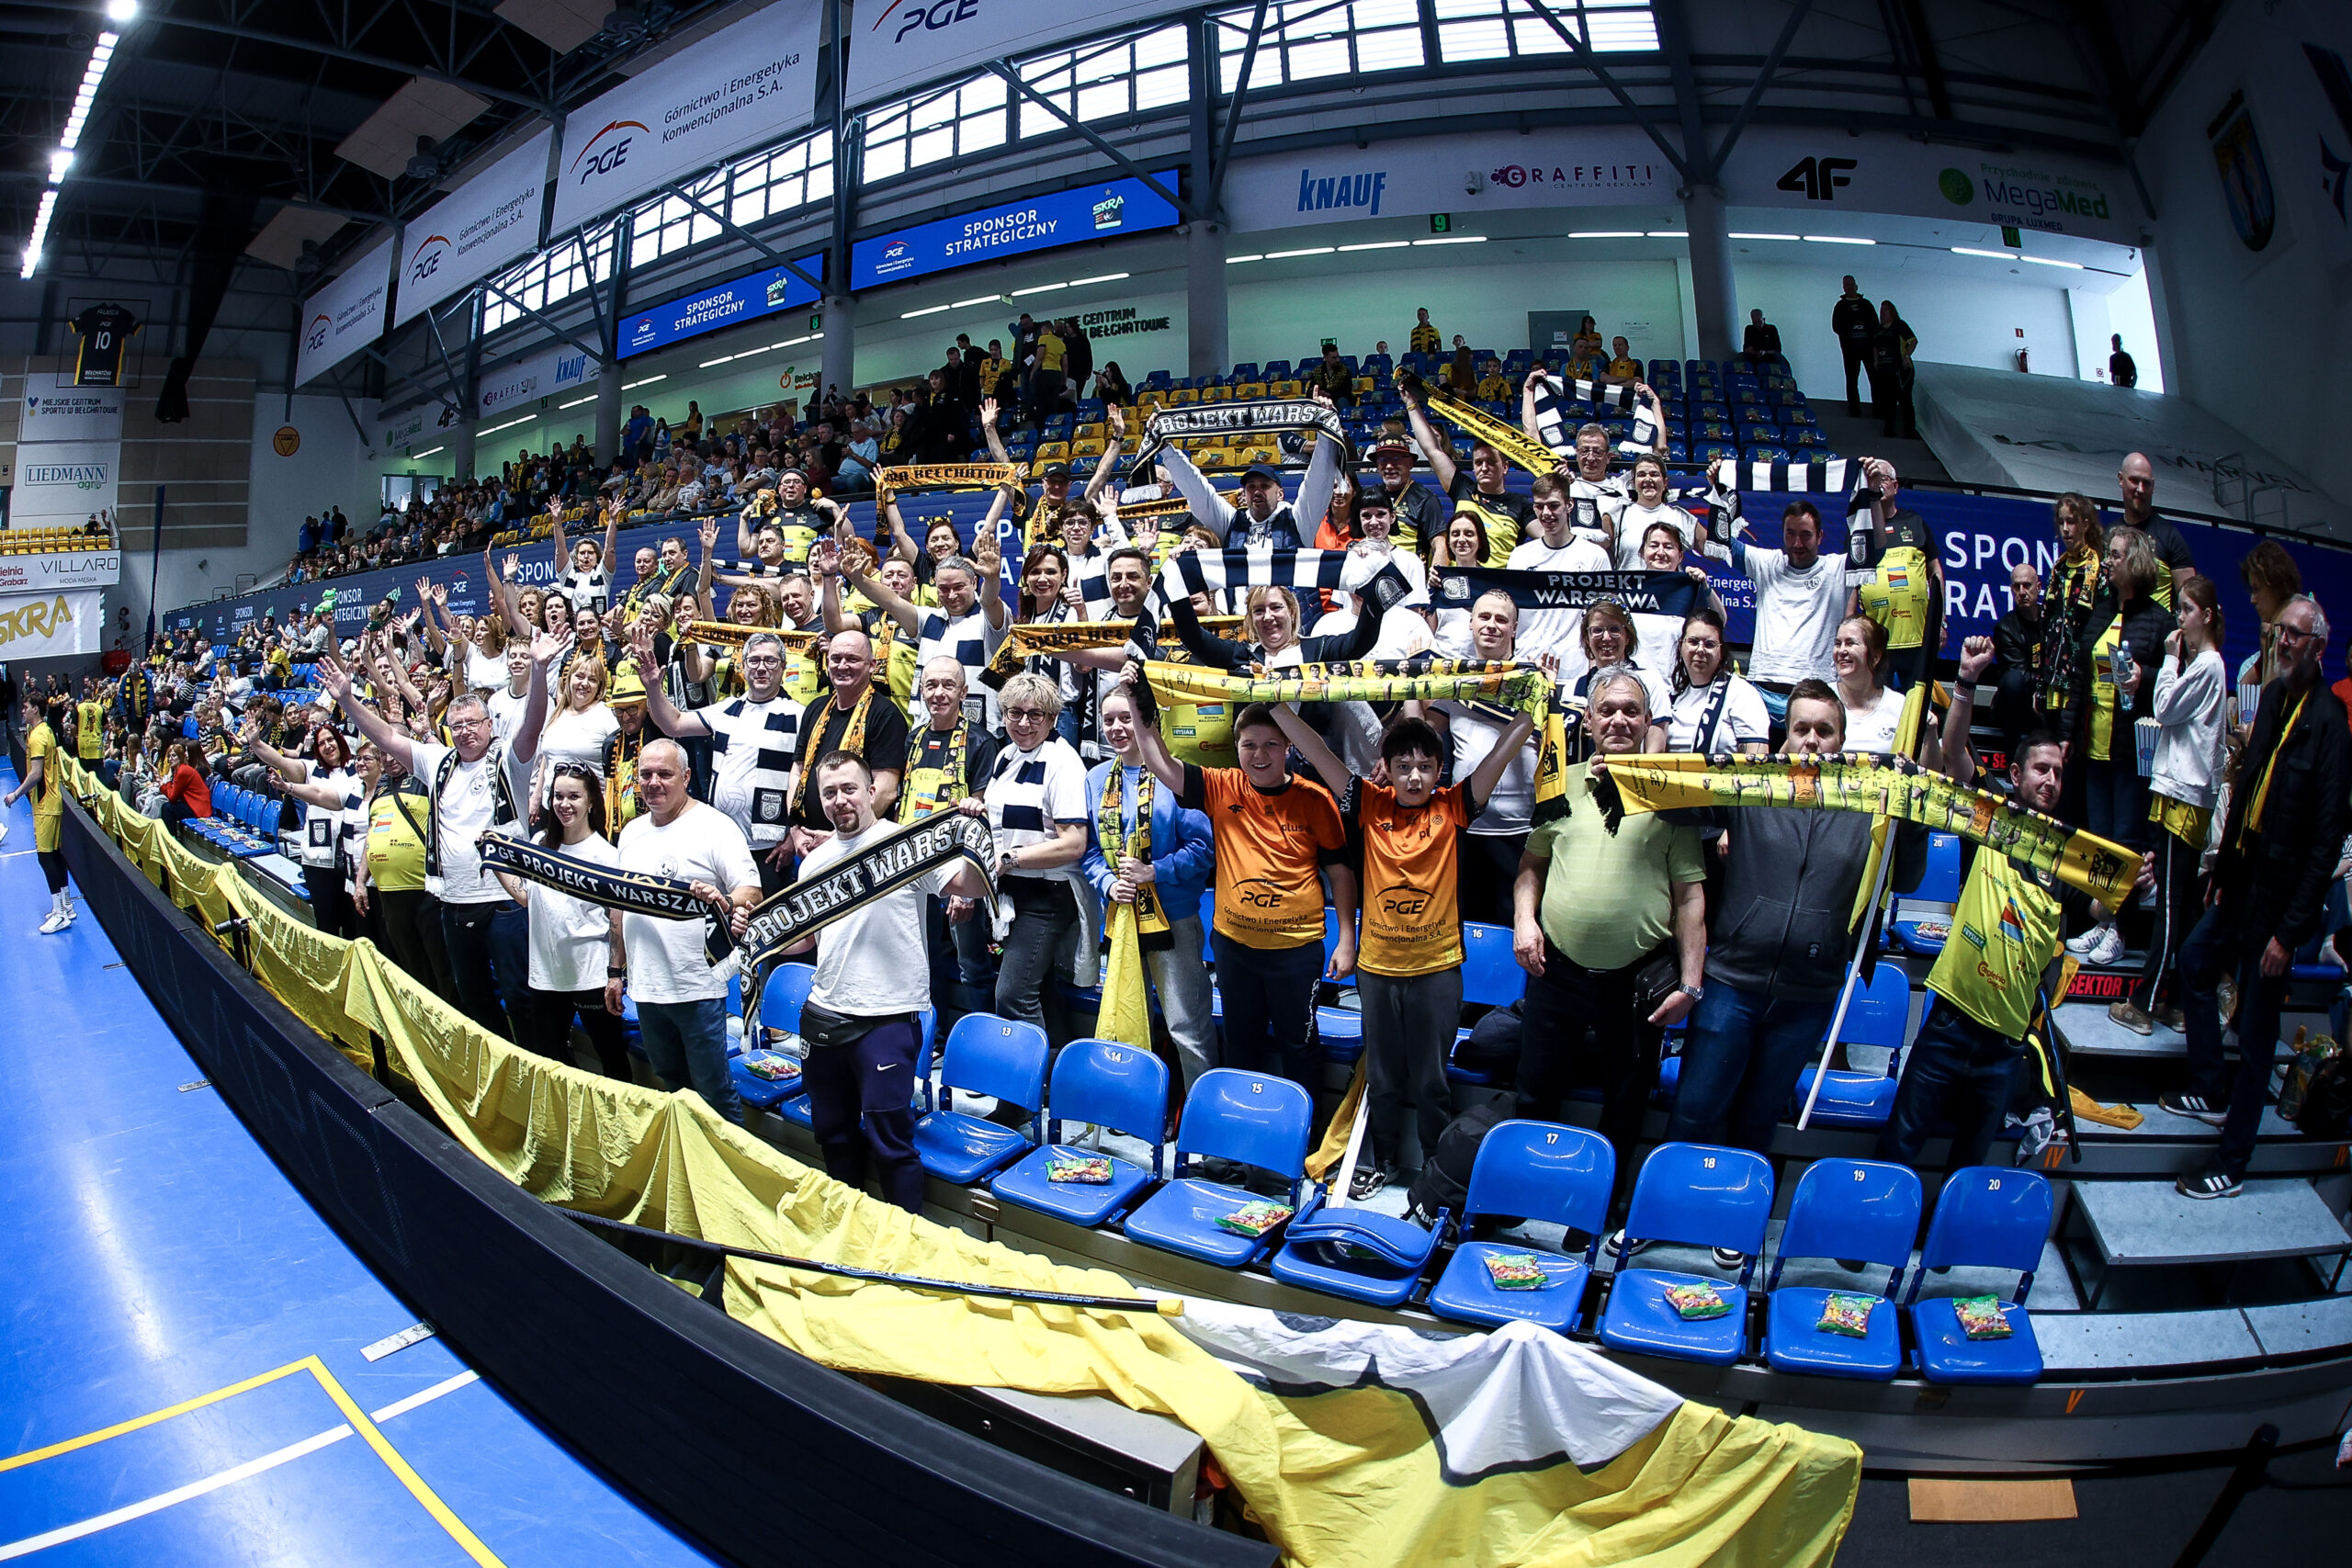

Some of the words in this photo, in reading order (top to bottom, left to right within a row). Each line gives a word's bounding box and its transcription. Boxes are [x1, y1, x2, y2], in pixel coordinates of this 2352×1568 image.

[894, 0, 979, 44] PGE
[664, 88, 720, 124] Górnictwo
[723, 83, 728, 97] i
[730, 52, 800, 93] Energetyka
[662, 93, 753, 143] Konwencjonalna
[757, 79, 784, 100] S.A.
[581, 137, 632, 185] PGE
[1507, 164, 1653, 187] GRAFFITI
[1776, 155, 1859, 200] 4F
[1092, 195, 1125, 216] SKRA
[1984, 179, 2110, 220] MegaMed
[458, 214, 491, 242] Górnictwo
[496, 187, 535, 220] Energetyka
[964, 209, 1038, 237] SPONSOR
[1435, 214, 1447, 231] 9
[1991, 212, 2022, 225] GRUPA
[2026, 217, 2064, 231] LUXMED
[458, 220, 508, 257] Konwencjonalna
[510, 213, 525, 226] S.A.
[945, 220, 1057, 256] STRATEGICZNY
[885, 247, 904, 259] PGE
[412, 250, 442, 287] PGE
[686, 290, 733, 315] SPONSOR
[674, 299, 745, 331] STRATEGICZNY
[812, 315, 819, 330] 8
[1082, 308, 1136, 326] CENTRUM
[638, 323, 650, 333] PGE
[95, 331, 111, 350] 10
[306, 328, 327, 355] PGE
[41, 406, 66, 415] SPORTU
[42, 398, 71, 406] MIEJSKIE
[72, 398, 102, 406] CENTRUM
[1461, 408, 1504, 431] PGE
[1505, 433, 1562, 469] SKRA
[28, 467, 106, 482] LIEDMANN
[1945, 531, 2059, 575] SPON
[452, 581, 468, 593] PGE
[1547, 574, 1646, 590] PROJEKT
[334, 588, 362, 604] PONSOR
[1281, 823, 1304, 833] plus
[1933, 839, 1943, 847] 20
[485, 843, 517, 863] PGE
[522, 853, 598, 892] PROJEKT
[1240, 891, 1283, 908] PGE
[1384, 899, 1425, 915] PGE
[741, 863, 865, 955] PROJEKT
[1224, 906, 1257, 925] Górnictwo
[1264, 914, 1308, 926] Energetyka
[1368, 918, 1399, 932] Górnictwo
[1406, 919, 1447, 932] Energetyka
[1472, 928, 1483, 938] 16
[1370, 930, 1427, 943] Konwencjonalna
[1429, 930, 1444, 938] S.A.
[2067, 975, 2122, 997] SEKTOR
[1001, 1026, 1012, 1036] 13
[1111, 1052, 1122, 1062] 14
[1250, 1082, 1262, 1094] 15
[1545, 1133, 1559, 1145] 17
[1702, 1157, 1716, 1169] 18
[1852, 1169, 1865, 1182] 19
[1988, 1179, 2001, 1191] 20
